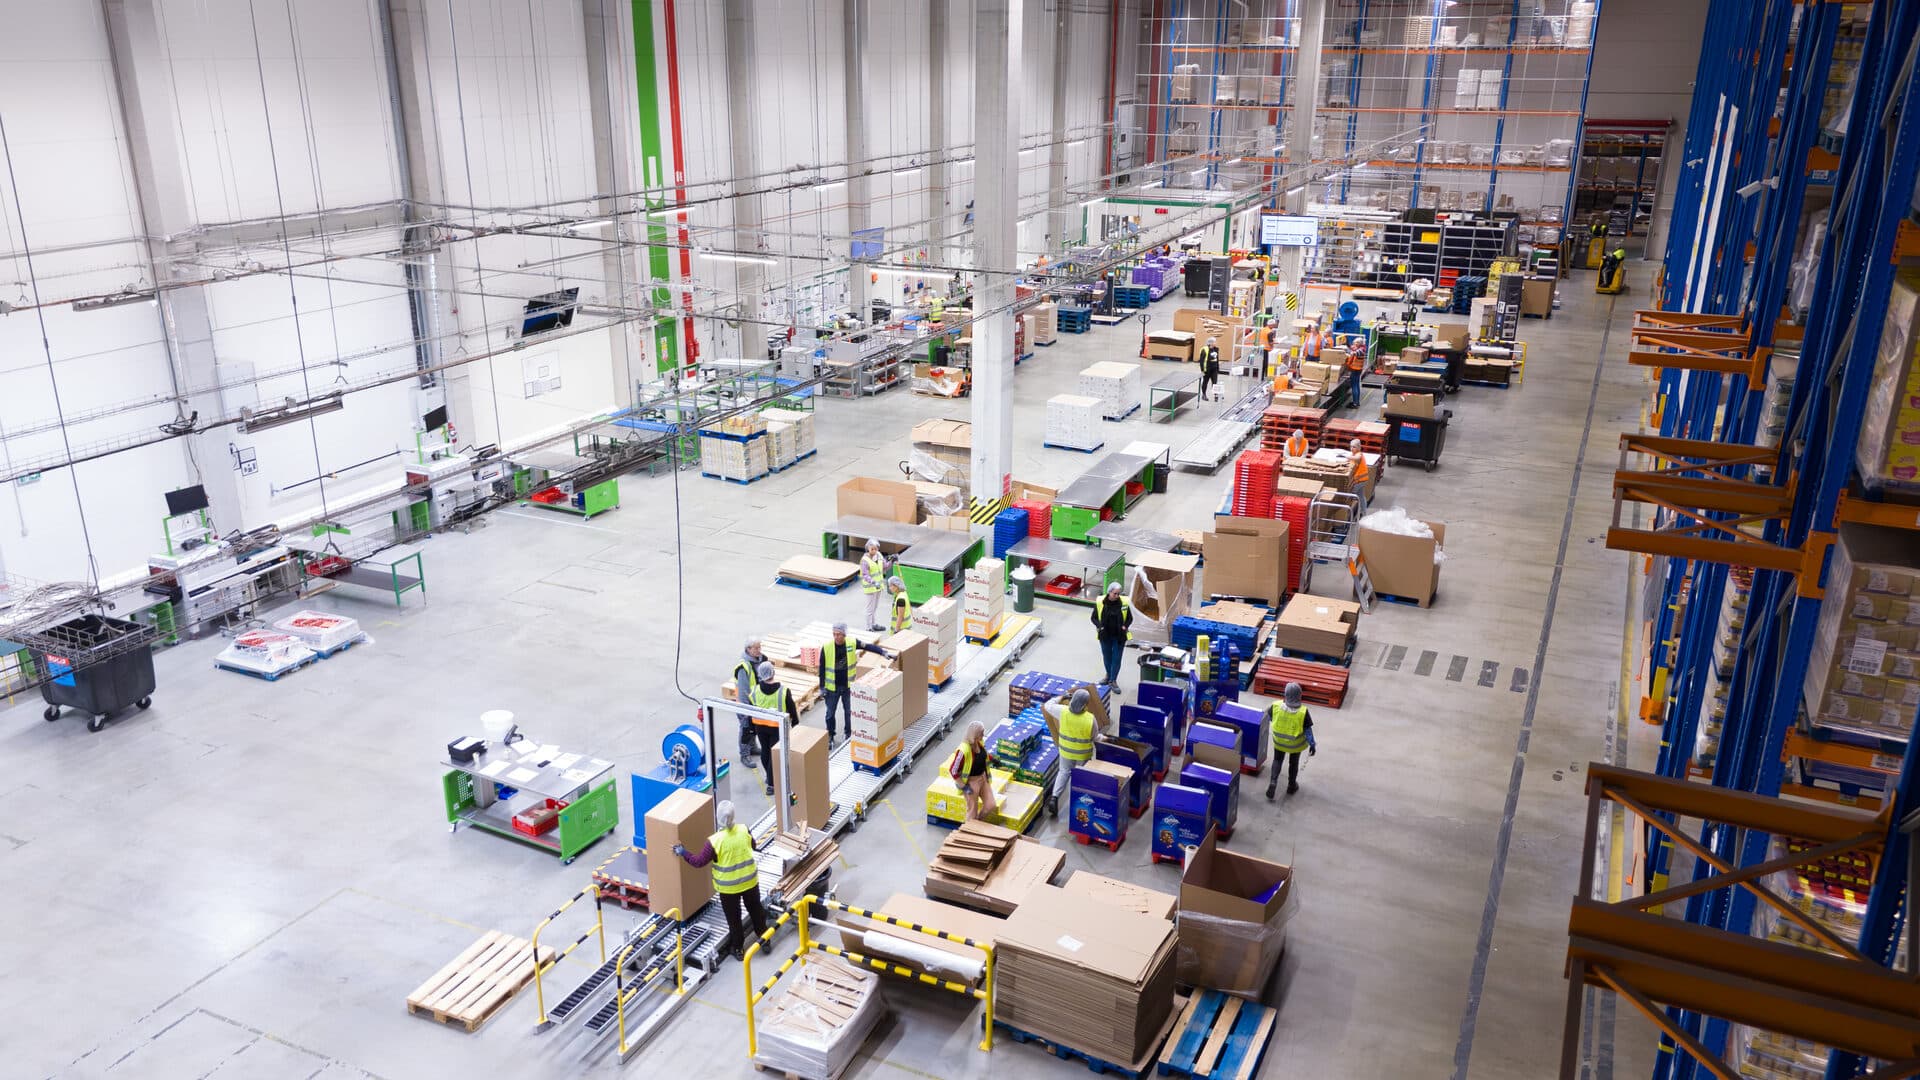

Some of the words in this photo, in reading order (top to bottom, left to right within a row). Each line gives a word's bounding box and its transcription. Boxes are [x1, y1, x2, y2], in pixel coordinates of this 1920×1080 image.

[912, 616, 939, 627] Marlenka
[850, 690, 878, 703] Marlenka
[850, 710, 879, 722] Marlenka
[851, 730, 879, 742] Marlenka
